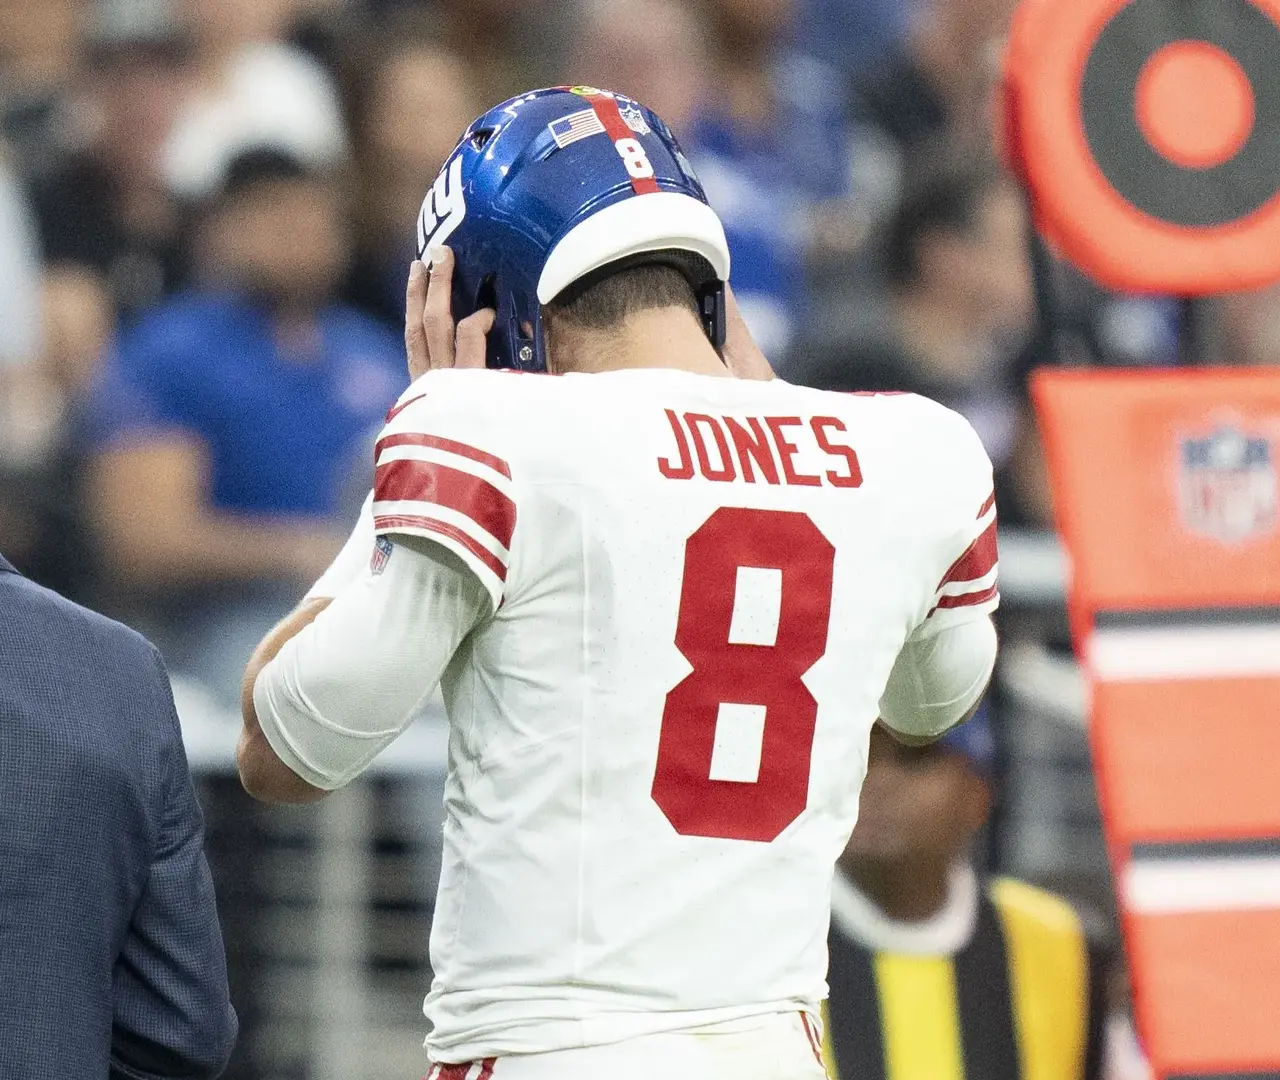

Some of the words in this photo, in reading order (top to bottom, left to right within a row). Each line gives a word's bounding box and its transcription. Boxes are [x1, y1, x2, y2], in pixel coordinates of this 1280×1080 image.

[614, 138, 654, 178] 8
[657, 408, 863, 488] JONES
[651, 506, 836, 842] 8
